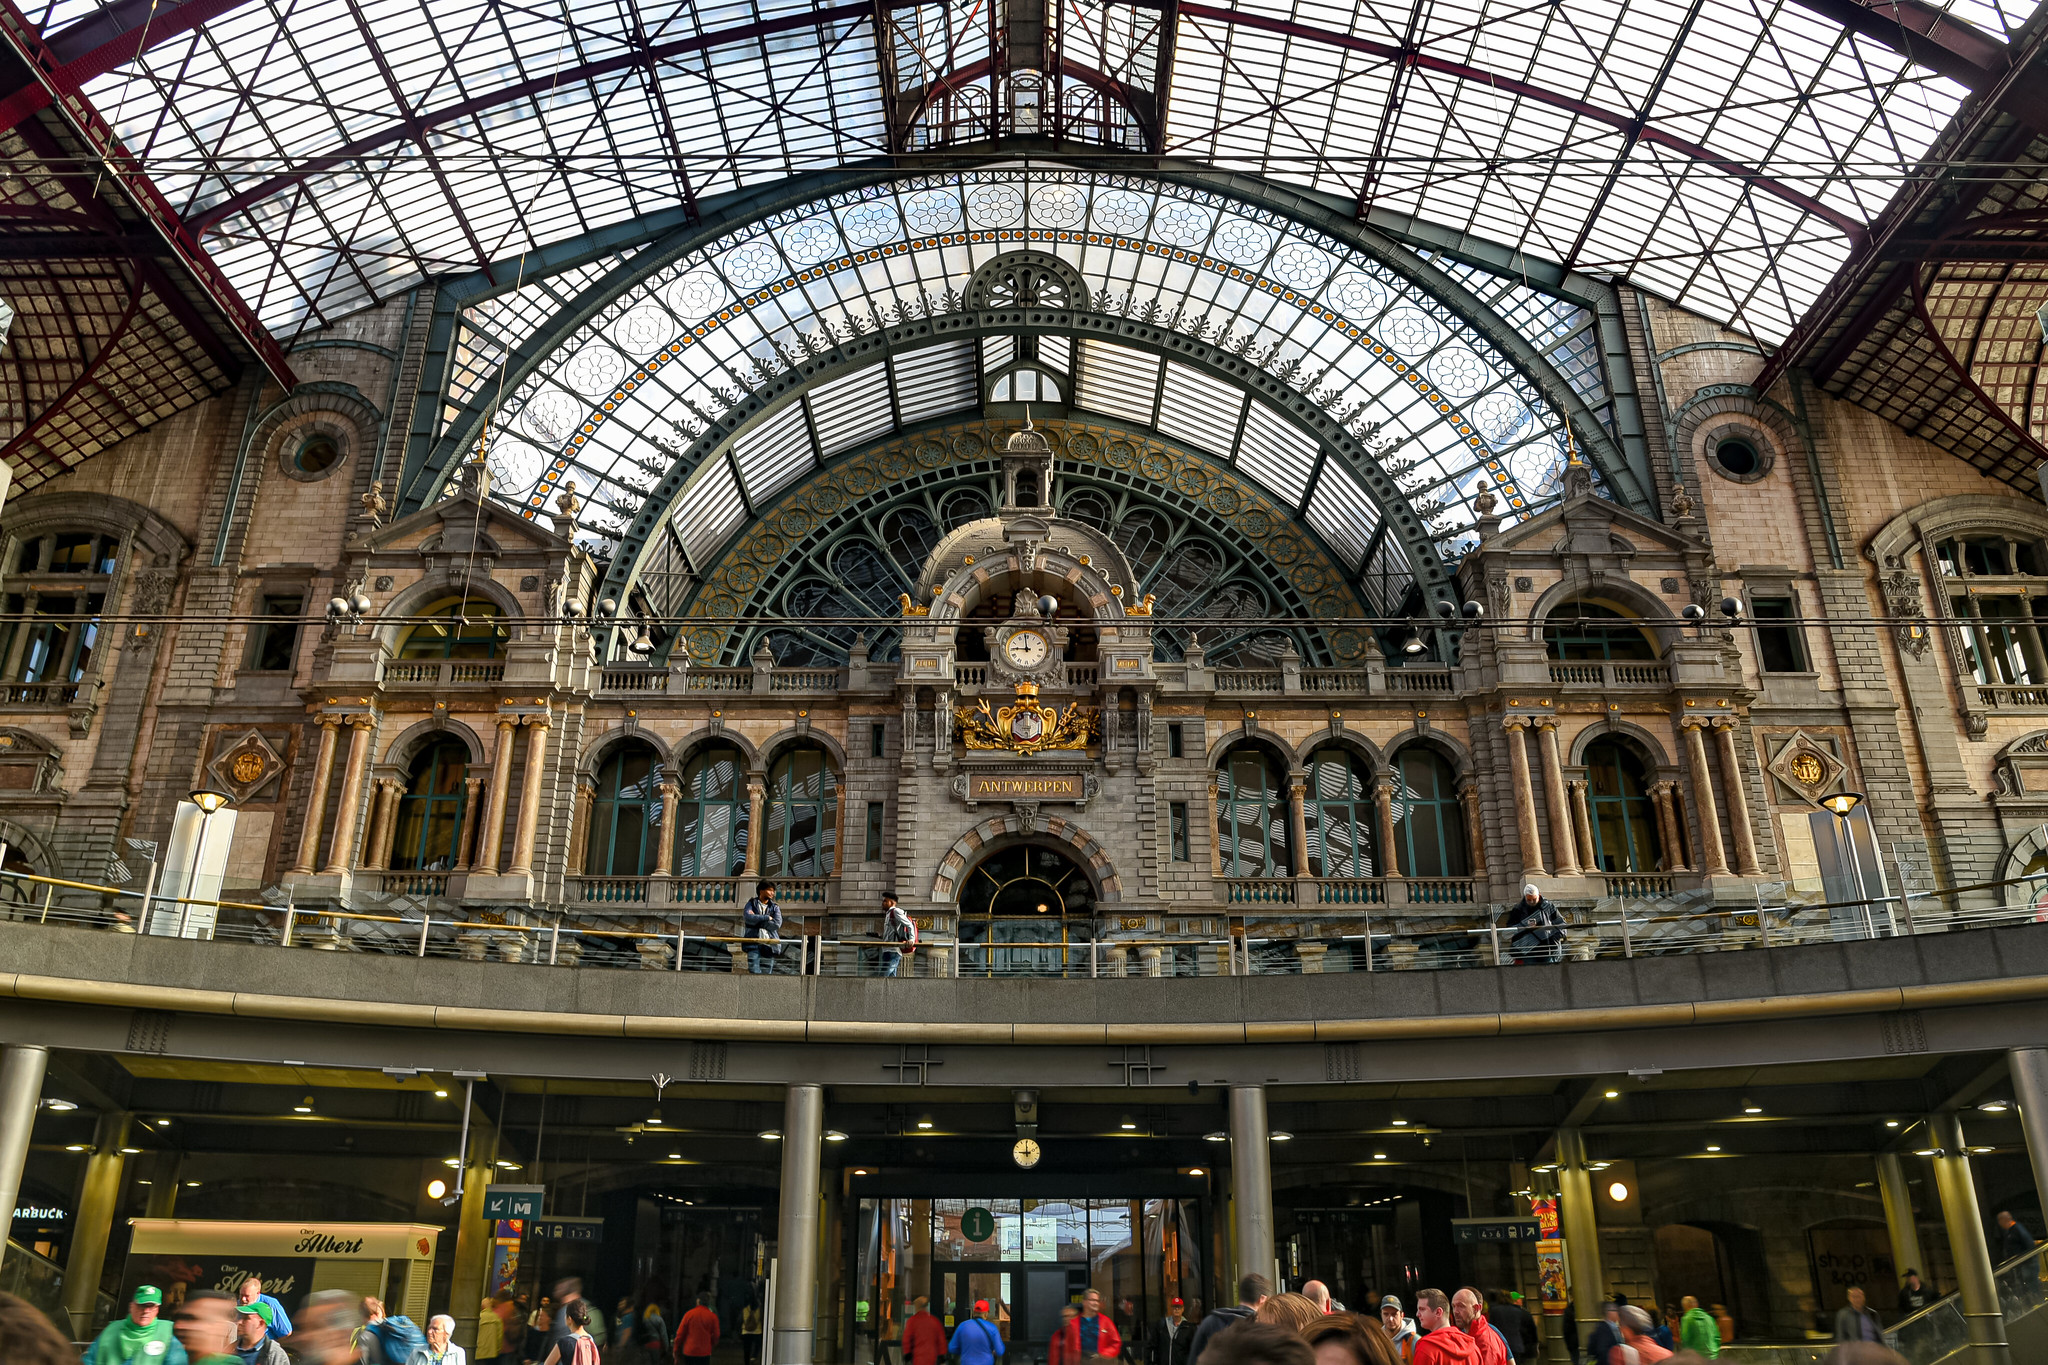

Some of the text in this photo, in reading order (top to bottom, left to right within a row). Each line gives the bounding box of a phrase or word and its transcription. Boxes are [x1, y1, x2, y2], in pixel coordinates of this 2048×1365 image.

[978, 780, 1073, 793] ANTWERPEN
[12, 1207, 68, 1219] ARBUCK
[294, 1233, 363, 1253] Albert
[1818, 1250, 1865, 1270] shop
